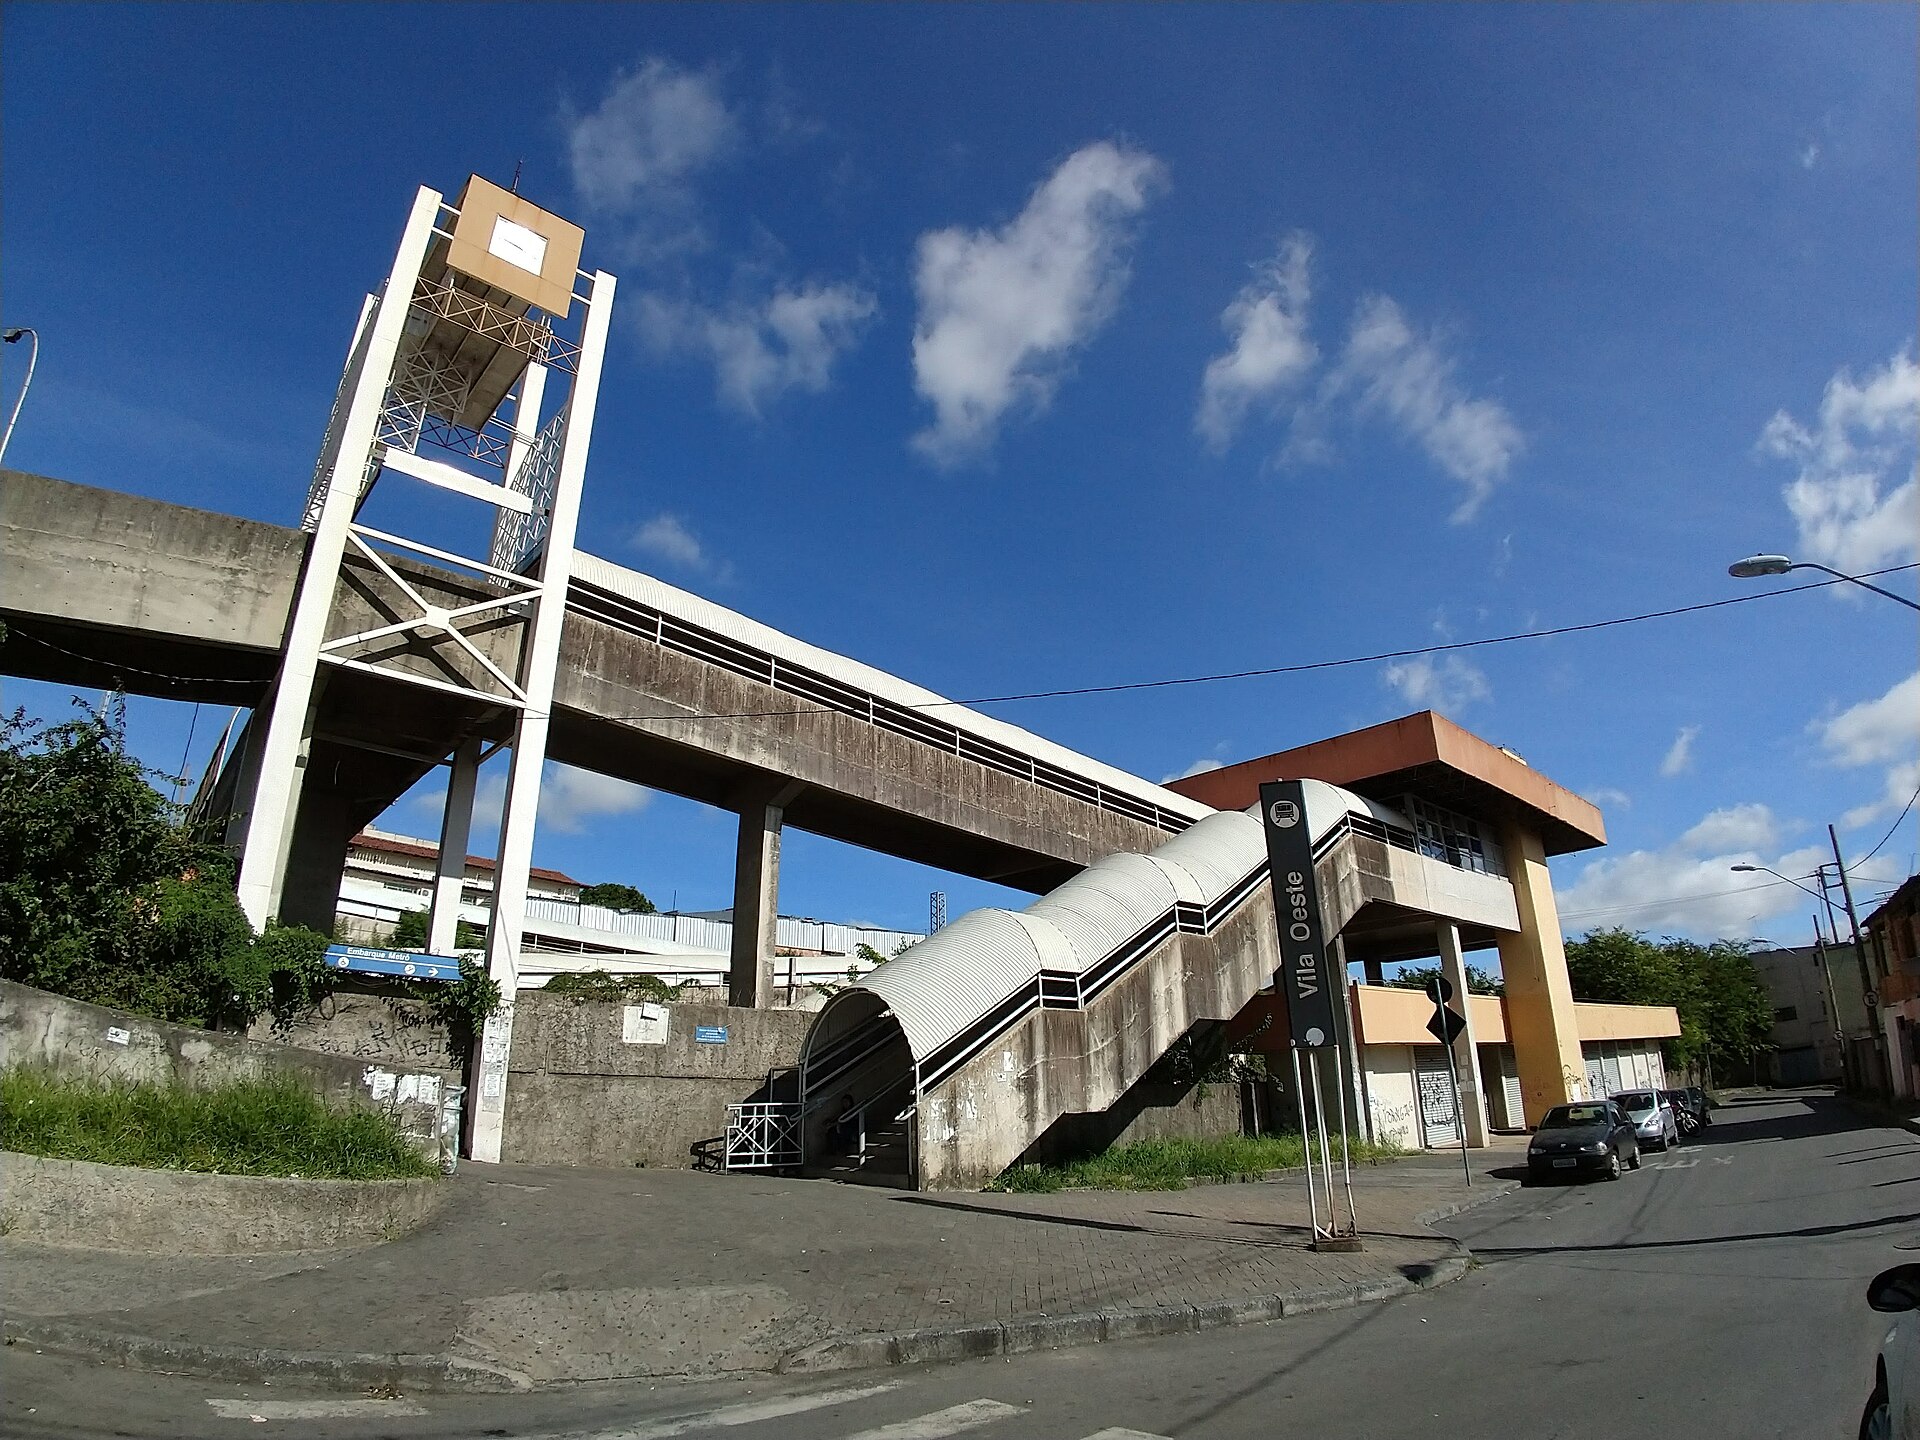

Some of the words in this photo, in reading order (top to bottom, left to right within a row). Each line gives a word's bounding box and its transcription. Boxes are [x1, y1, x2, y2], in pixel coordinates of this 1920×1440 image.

[1286, 871, 1310, 941] Oeste
[347, 947, 386, 959] Embarque
[1296, 953, 1318, 999] Vila
